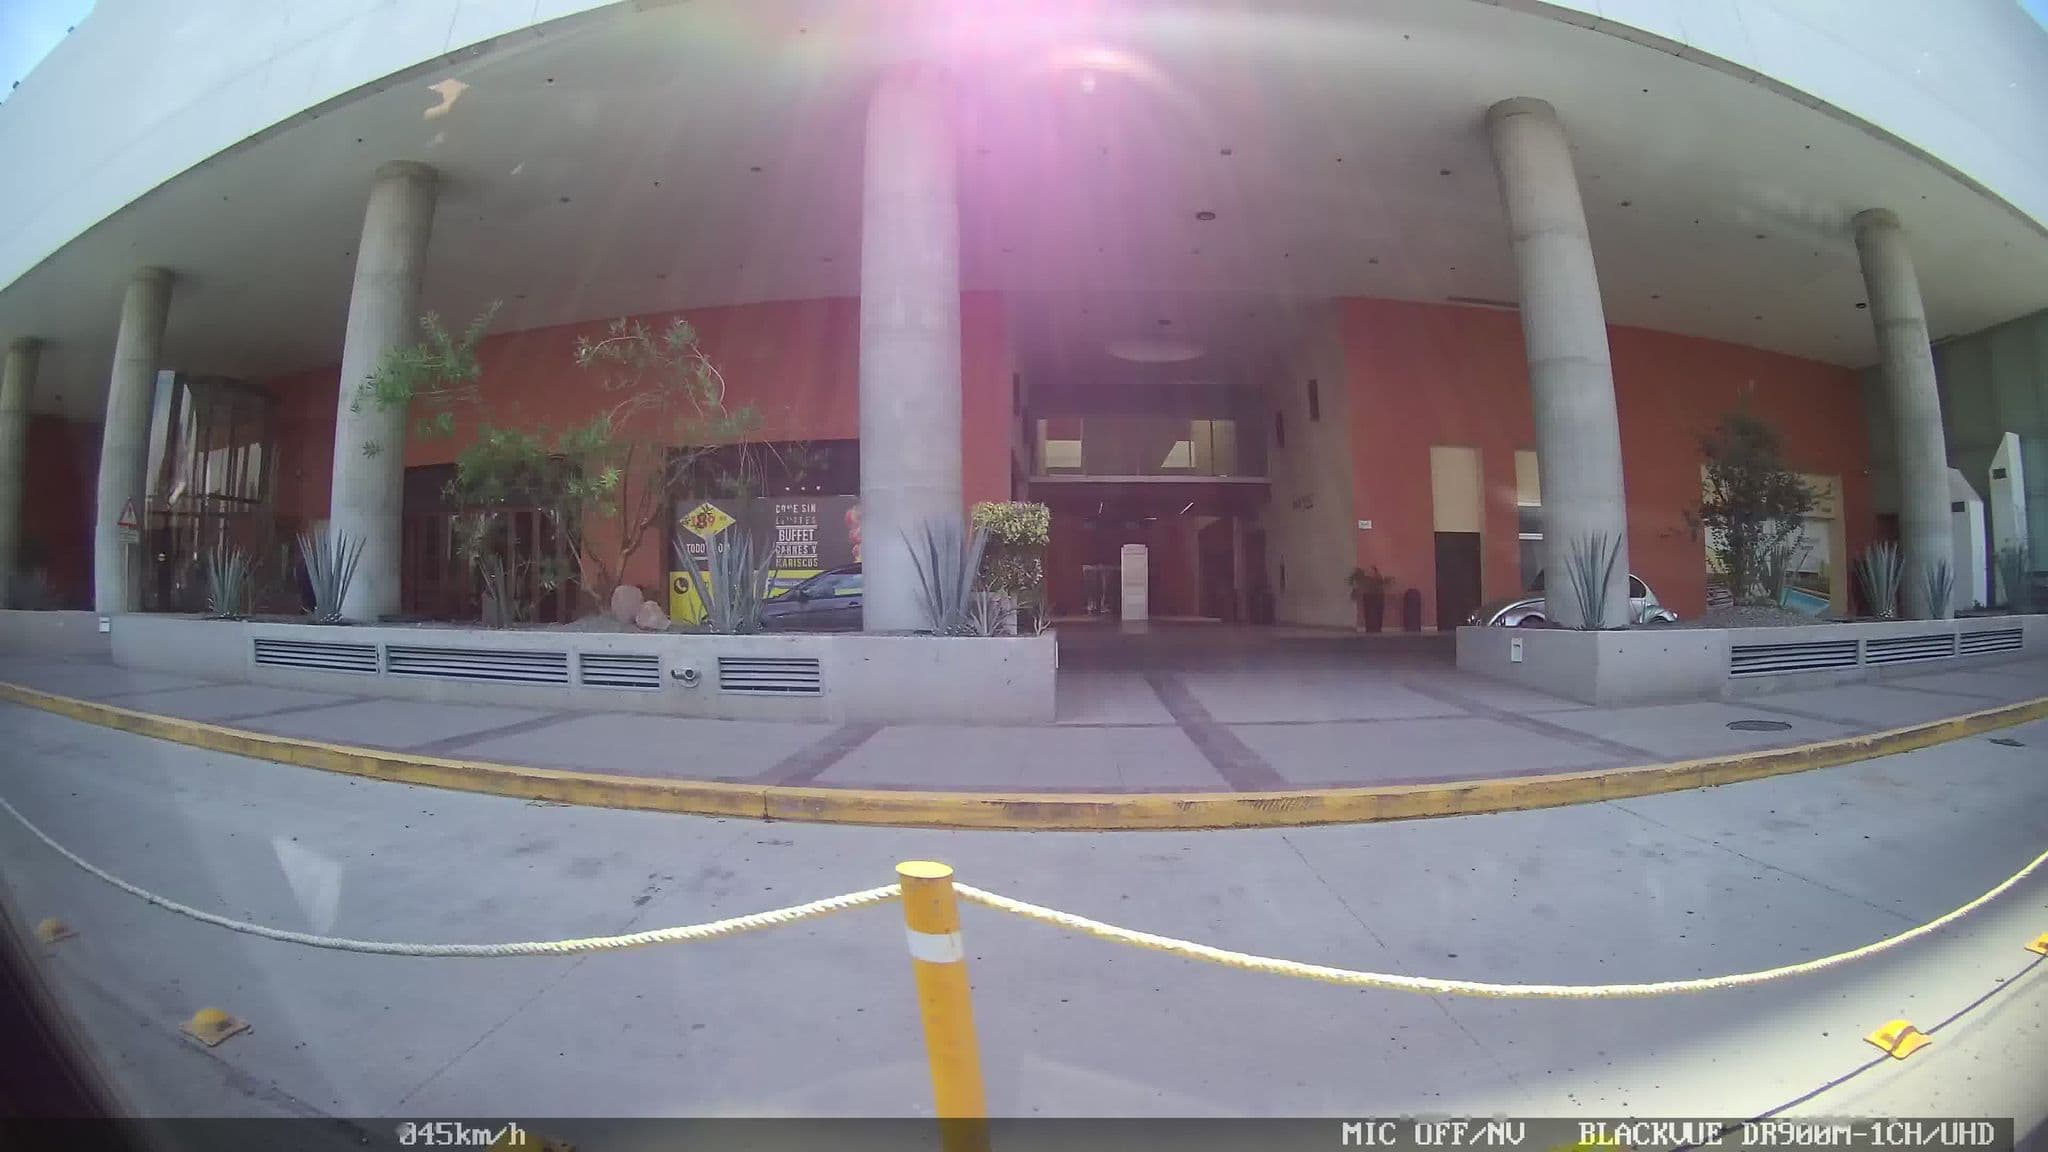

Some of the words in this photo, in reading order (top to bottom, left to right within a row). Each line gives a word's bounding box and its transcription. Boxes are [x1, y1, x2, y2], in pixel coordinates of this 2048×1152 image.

[801, 503, 816, 513] SIN
[778, 529, 815, 541] BUFFET
[687, 543, 706, 554] TODO
